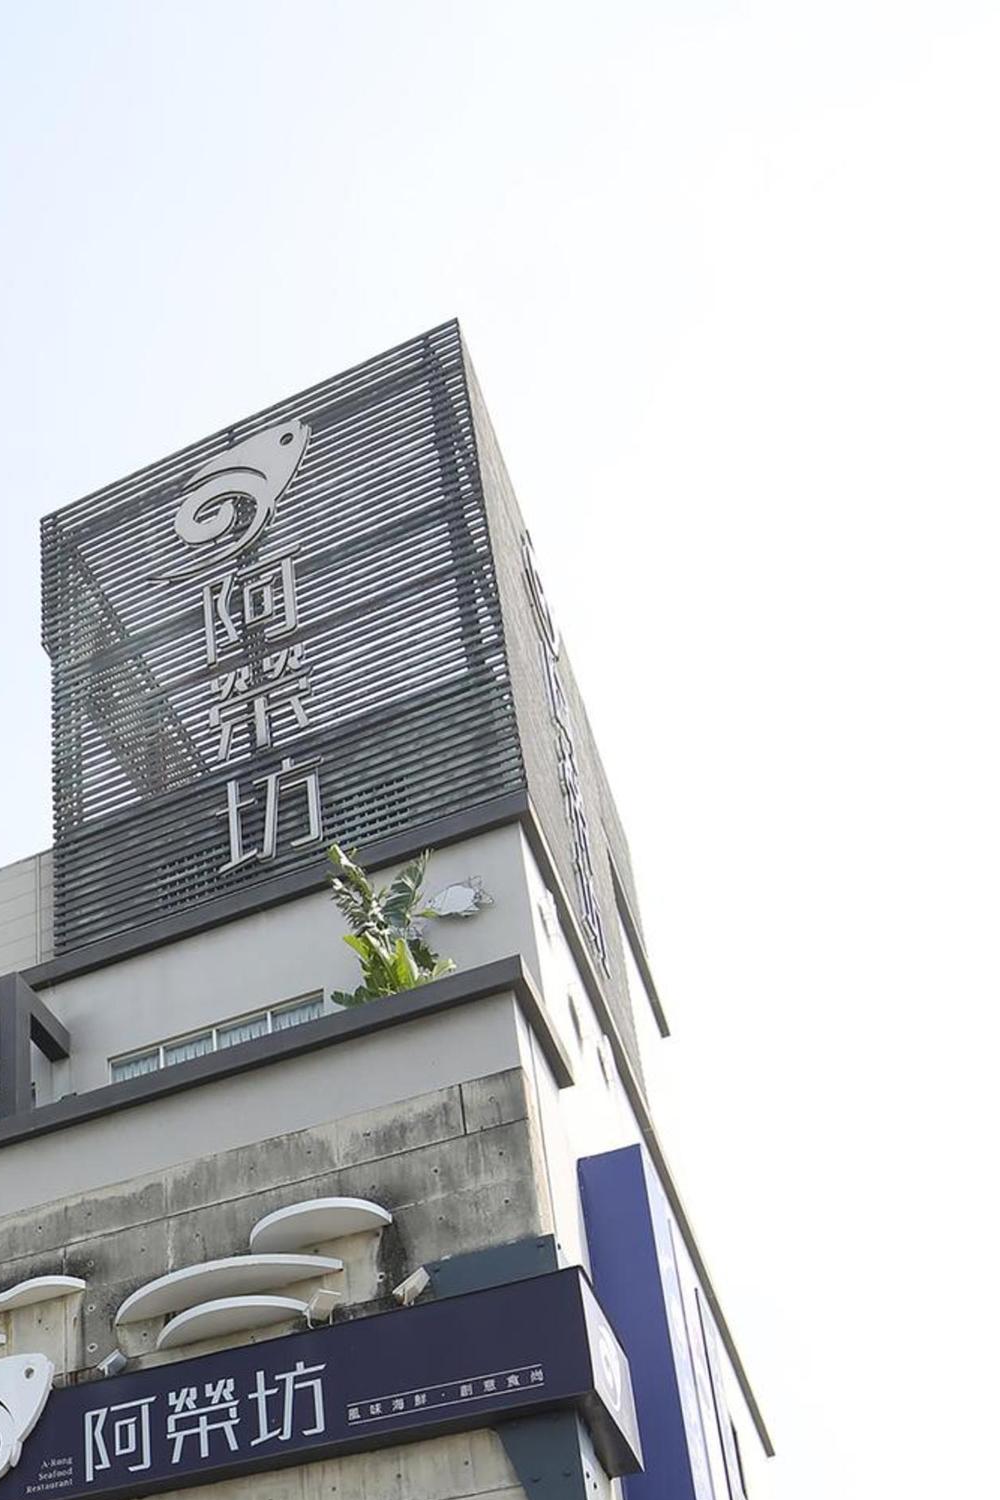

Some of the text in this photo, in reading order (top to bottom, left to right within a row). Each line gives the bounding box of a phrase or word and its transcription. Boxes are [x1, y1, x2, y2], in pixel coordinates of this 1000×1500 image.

[203, 545, 325, 876] 阿榮坊
[84, 1361, 327, 1483] 阿榮坊
[25, 1478, 73, 1494] Restaurant
